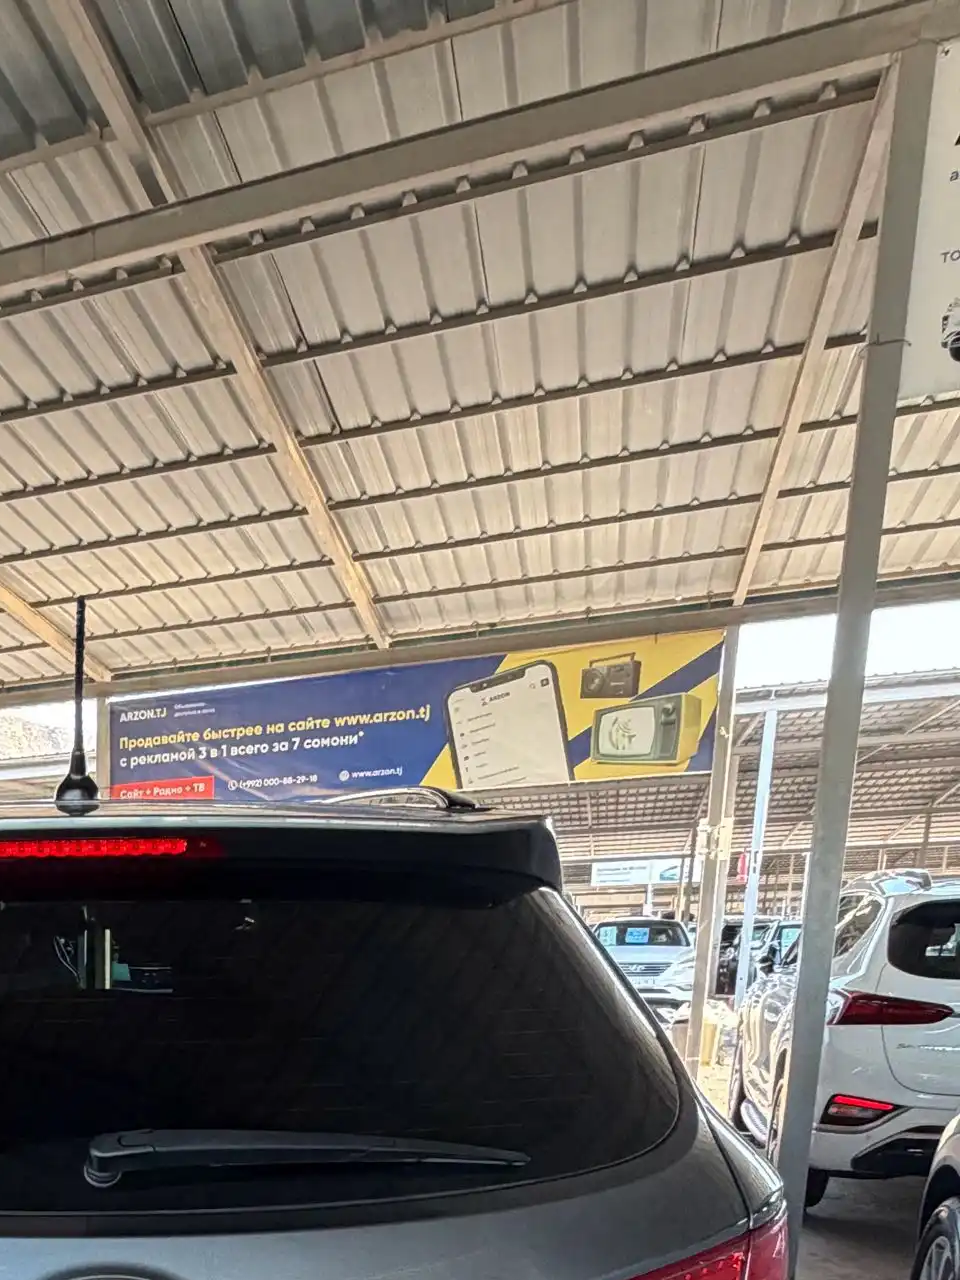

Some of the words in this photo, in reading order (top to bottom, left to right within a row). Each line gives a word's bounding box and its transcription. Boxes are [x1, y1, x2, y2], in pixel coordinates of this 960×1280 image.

[119, 707, 167, 722] ARZON.TJ
[119, 731, 200, 751] Продавайте
[203, 724, 263, 741] быстрее
[266, 723, 285, 735] на
[288, 717, 331, 733] сайте
[334, 704, 431, 727] www.arzon.tj
[119, 759, 128, 768] с
[130, 747, 195, 769] рекламой
[198, 746, 207, 760] 3
[210, 748, 218, 759] в
[221, 744, 228, 758] 1
[230, 742, 270, 757] всего
[272, 741, 289, 753] за
[291, 737, 301, 751] 7
[120, 788, 143, 800] Сайт
[193, 782, 206, 793] ТВ
